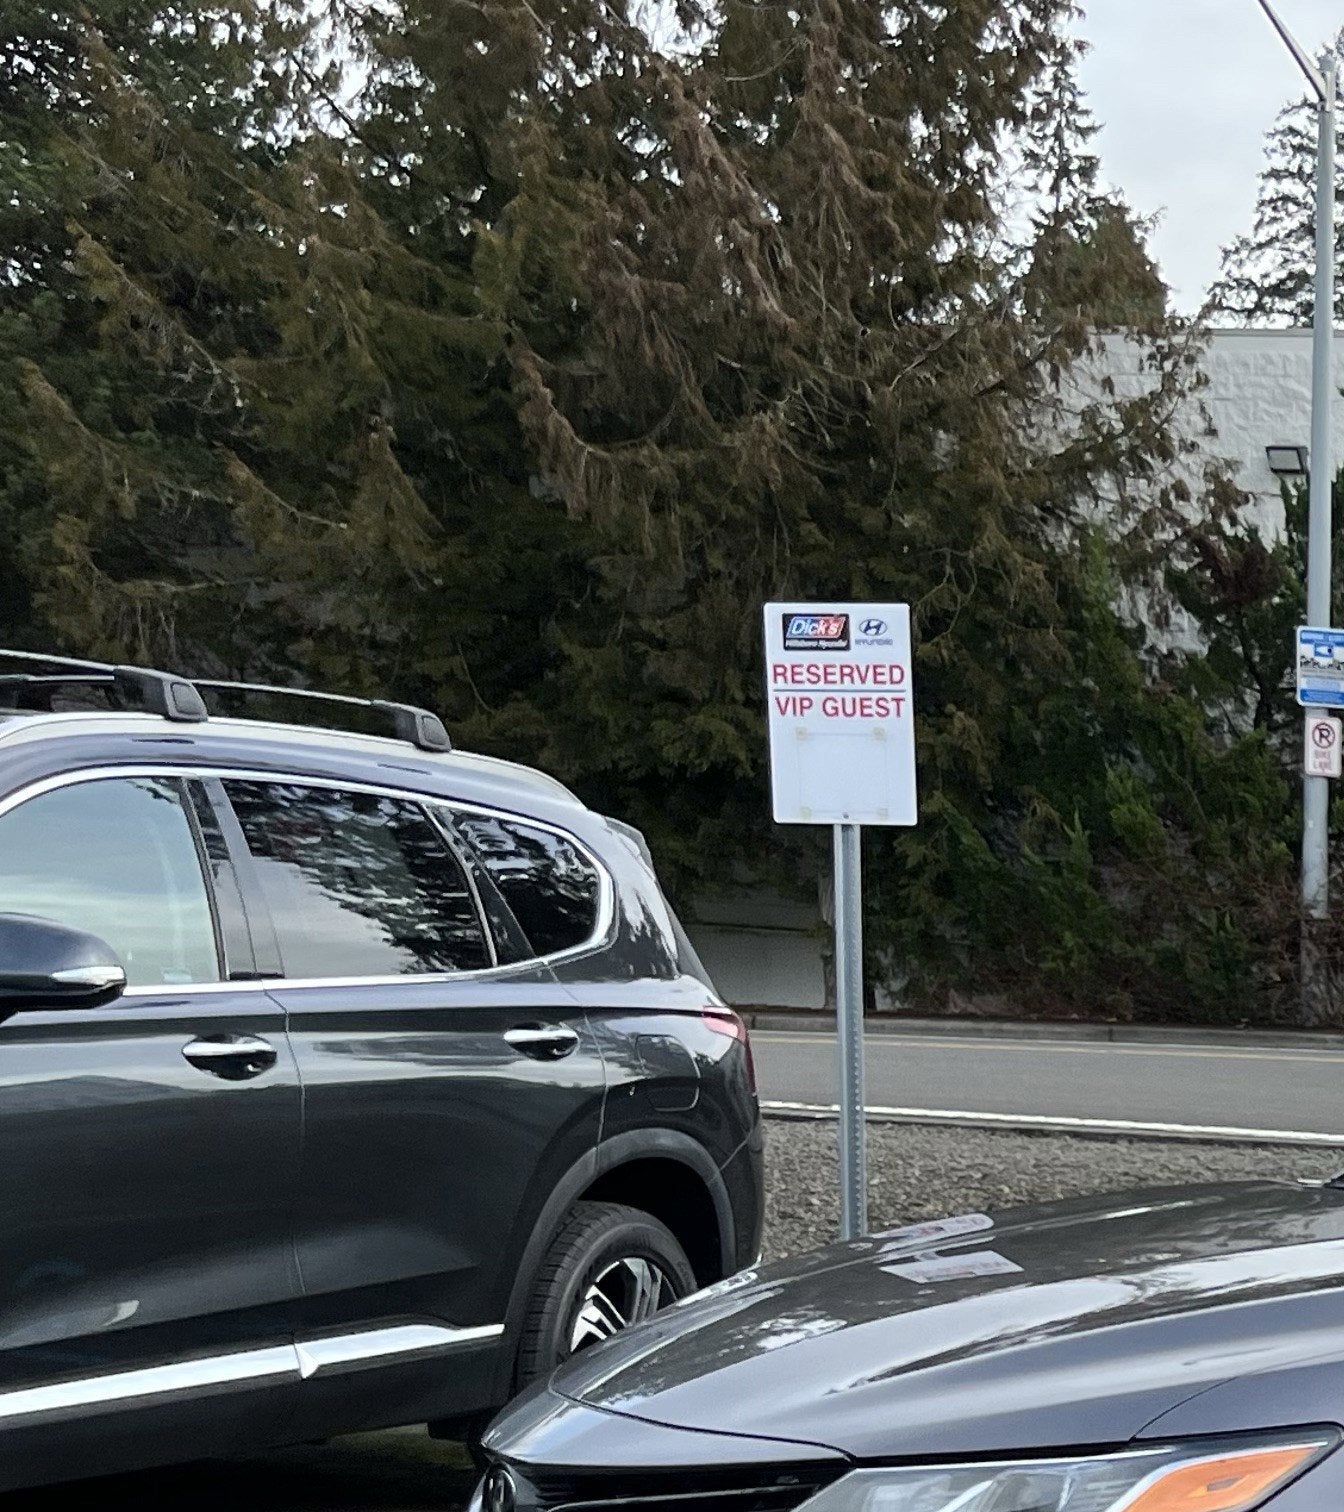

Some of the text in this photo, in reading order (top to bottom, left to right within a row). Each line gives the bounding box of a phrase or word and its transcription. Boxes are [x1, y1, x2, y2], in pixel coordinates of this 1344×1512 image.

[772, 663, 905, 685] RESERVED
[774, 696, 905, 718] VIP GUEST
